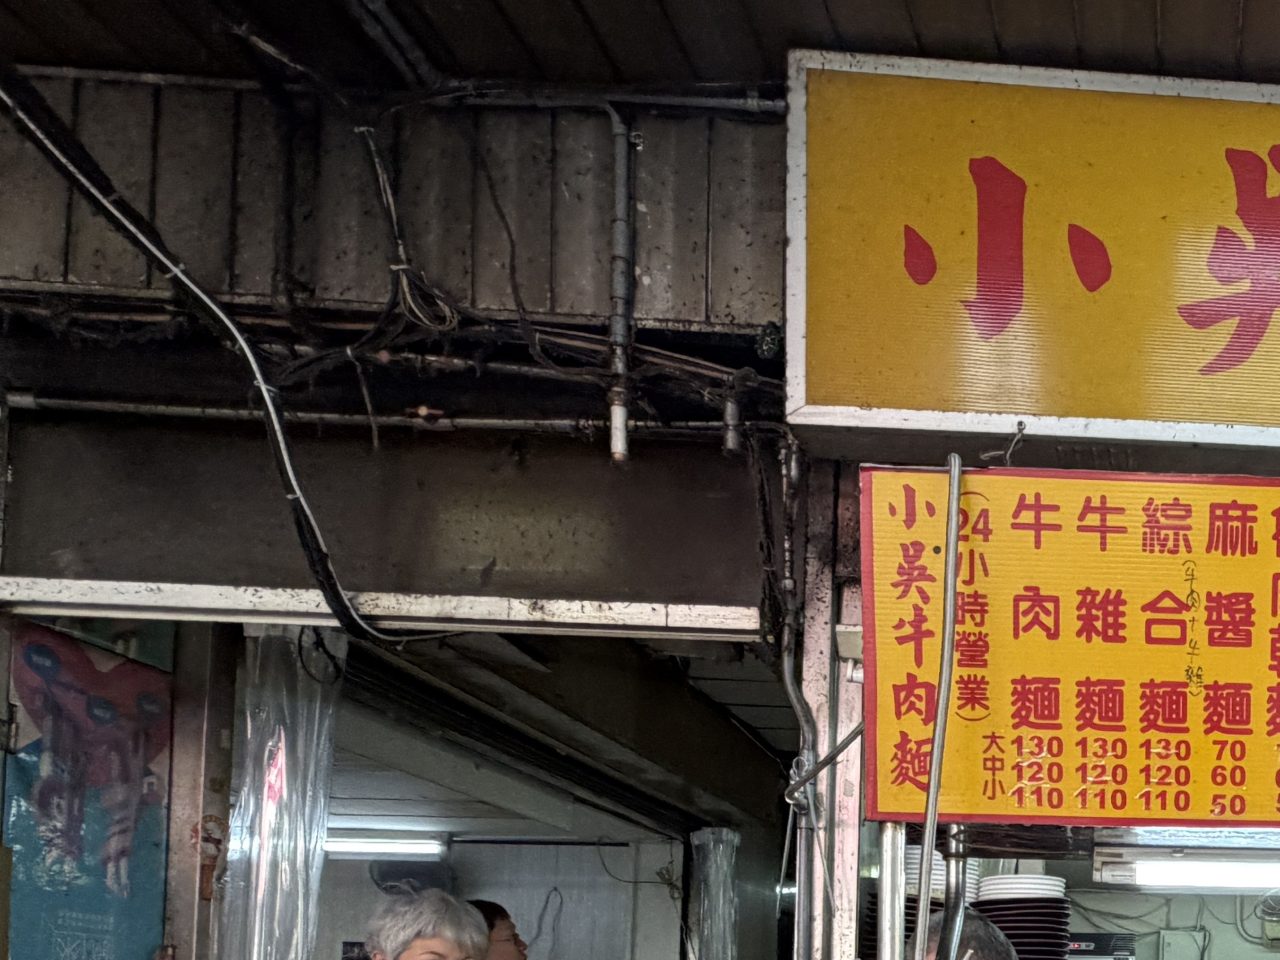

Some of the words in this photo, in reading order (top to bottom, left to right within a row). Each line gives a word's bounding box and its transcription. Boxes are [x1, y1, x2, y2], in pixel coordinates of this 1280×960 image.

[889, 484, 937, 793] 小吳牛肉麵
[1011, 493, 1062, 731] 牛肉麵
[1075, 495, 1127, 733] 牛雜麵
[1140, 497, 1193, 734] 綜合麵
[1203, 500, 1259, 736] 麻醬麵
[1012, 788, 1063, 808] 110
[1076, 789, 1127, 810] 110
[1141, 791, 1191, 811] 110
[1014, 737, 1063, 759] 130
[1077, 738, 1127, 760] 130
[1141, 740, 1192, 761] 130
[1214, 741, 1247, 761] 70
[1014, 763, 1063, 784] 120
[1077, 763, 1128, 785] 120
[1142, 765, 1191, 786] 120
[1211, 766, 1246, 787] 60
